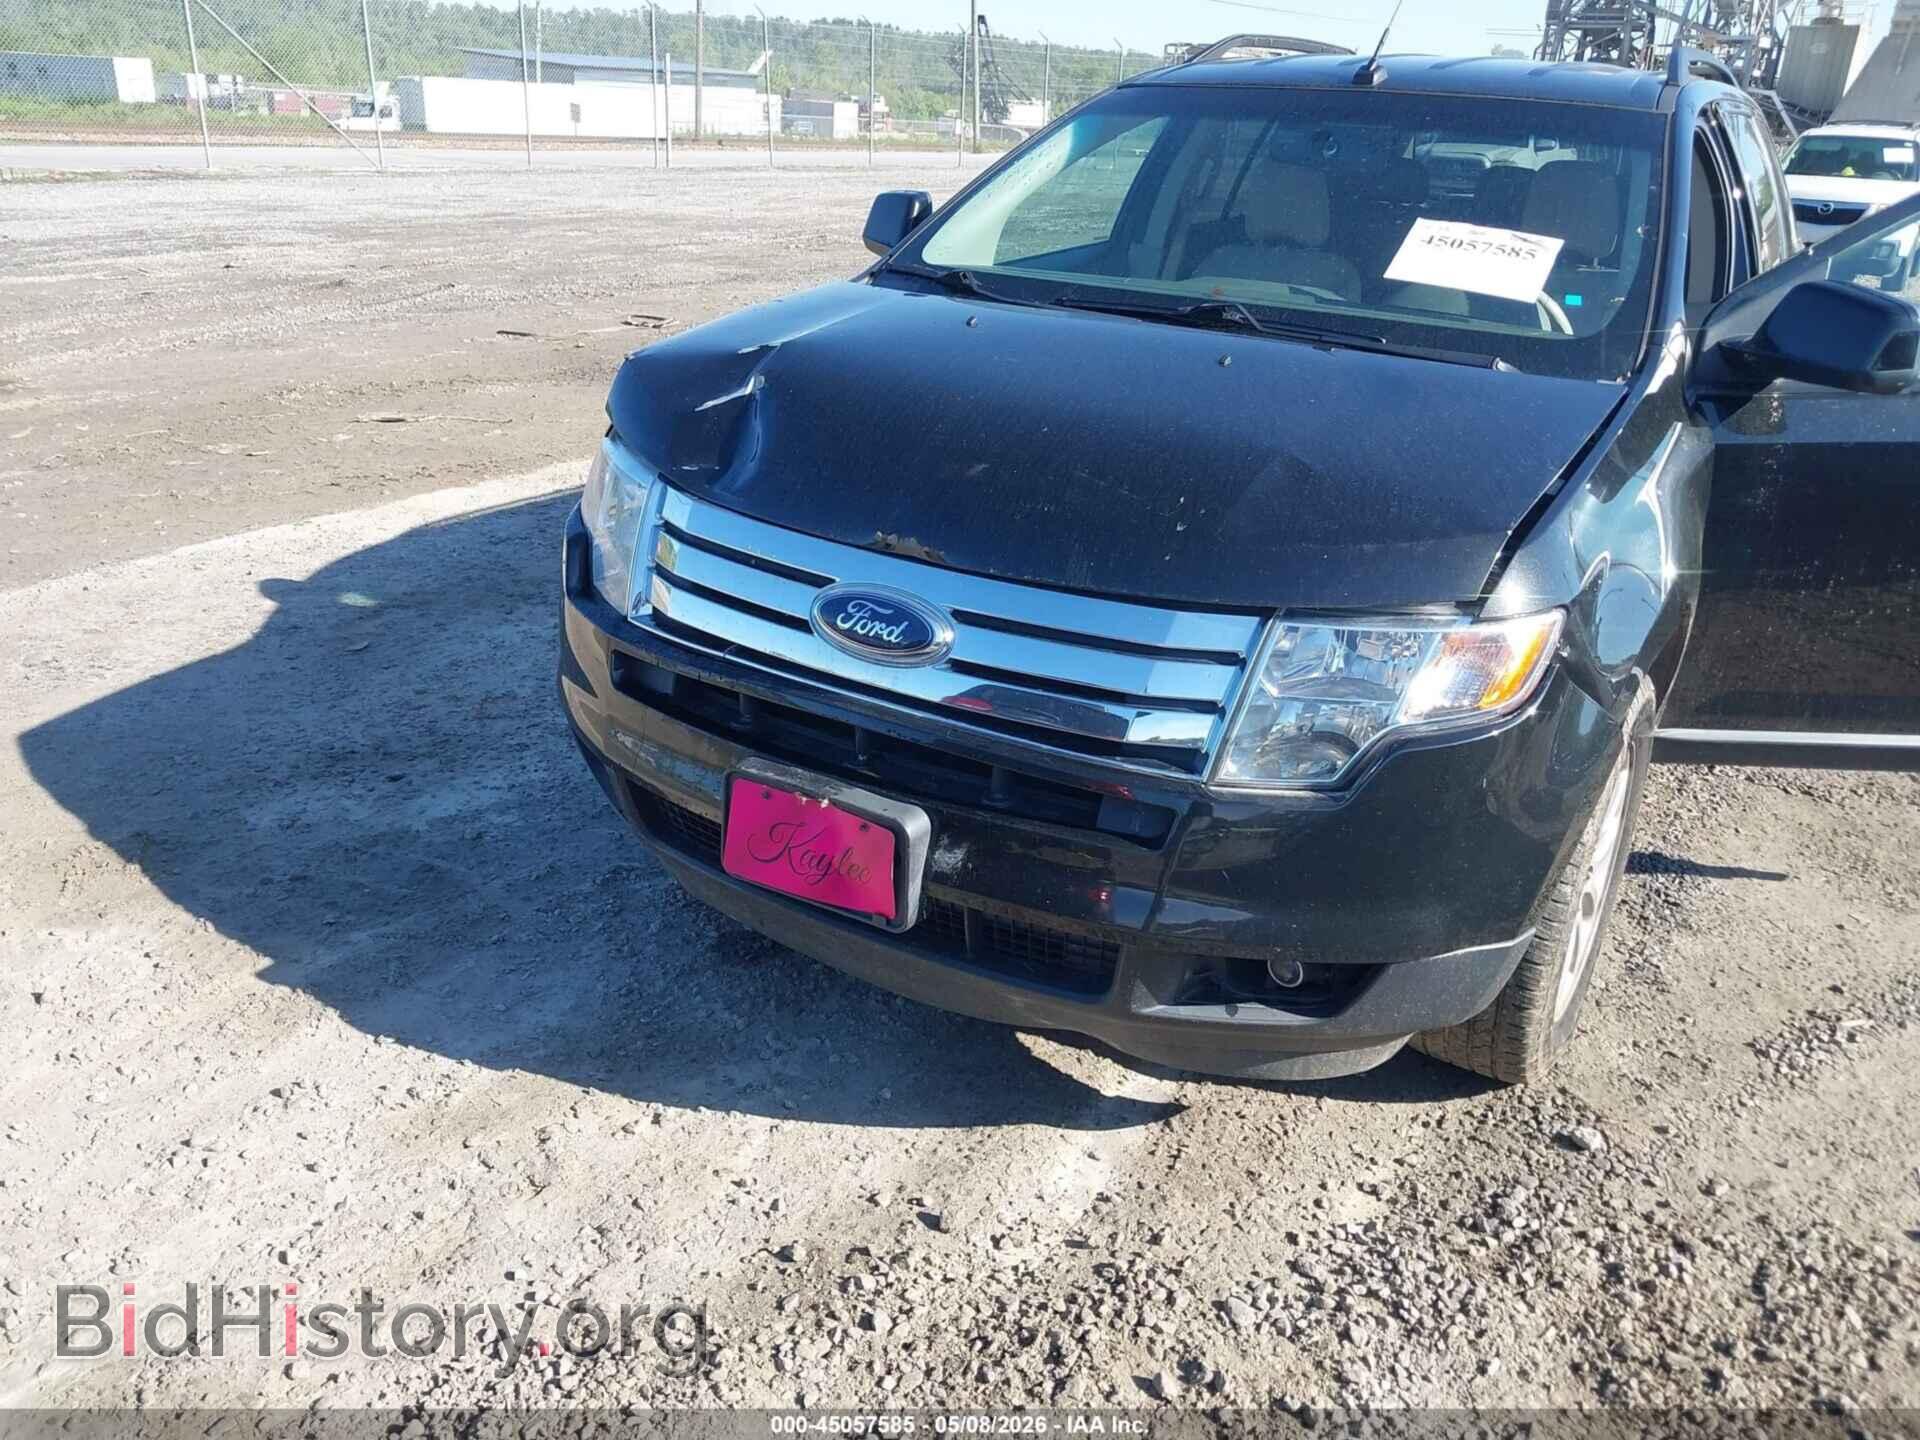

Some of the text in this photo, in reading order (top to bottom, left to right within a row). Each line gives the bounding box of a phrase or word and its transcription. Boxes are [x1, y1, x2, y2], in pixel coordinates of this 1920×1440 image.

[1421, 234, 1538, 260] 45057585
[836, 599, 907, 643] Ford
[746, 821, 873, 885] Kaylee
